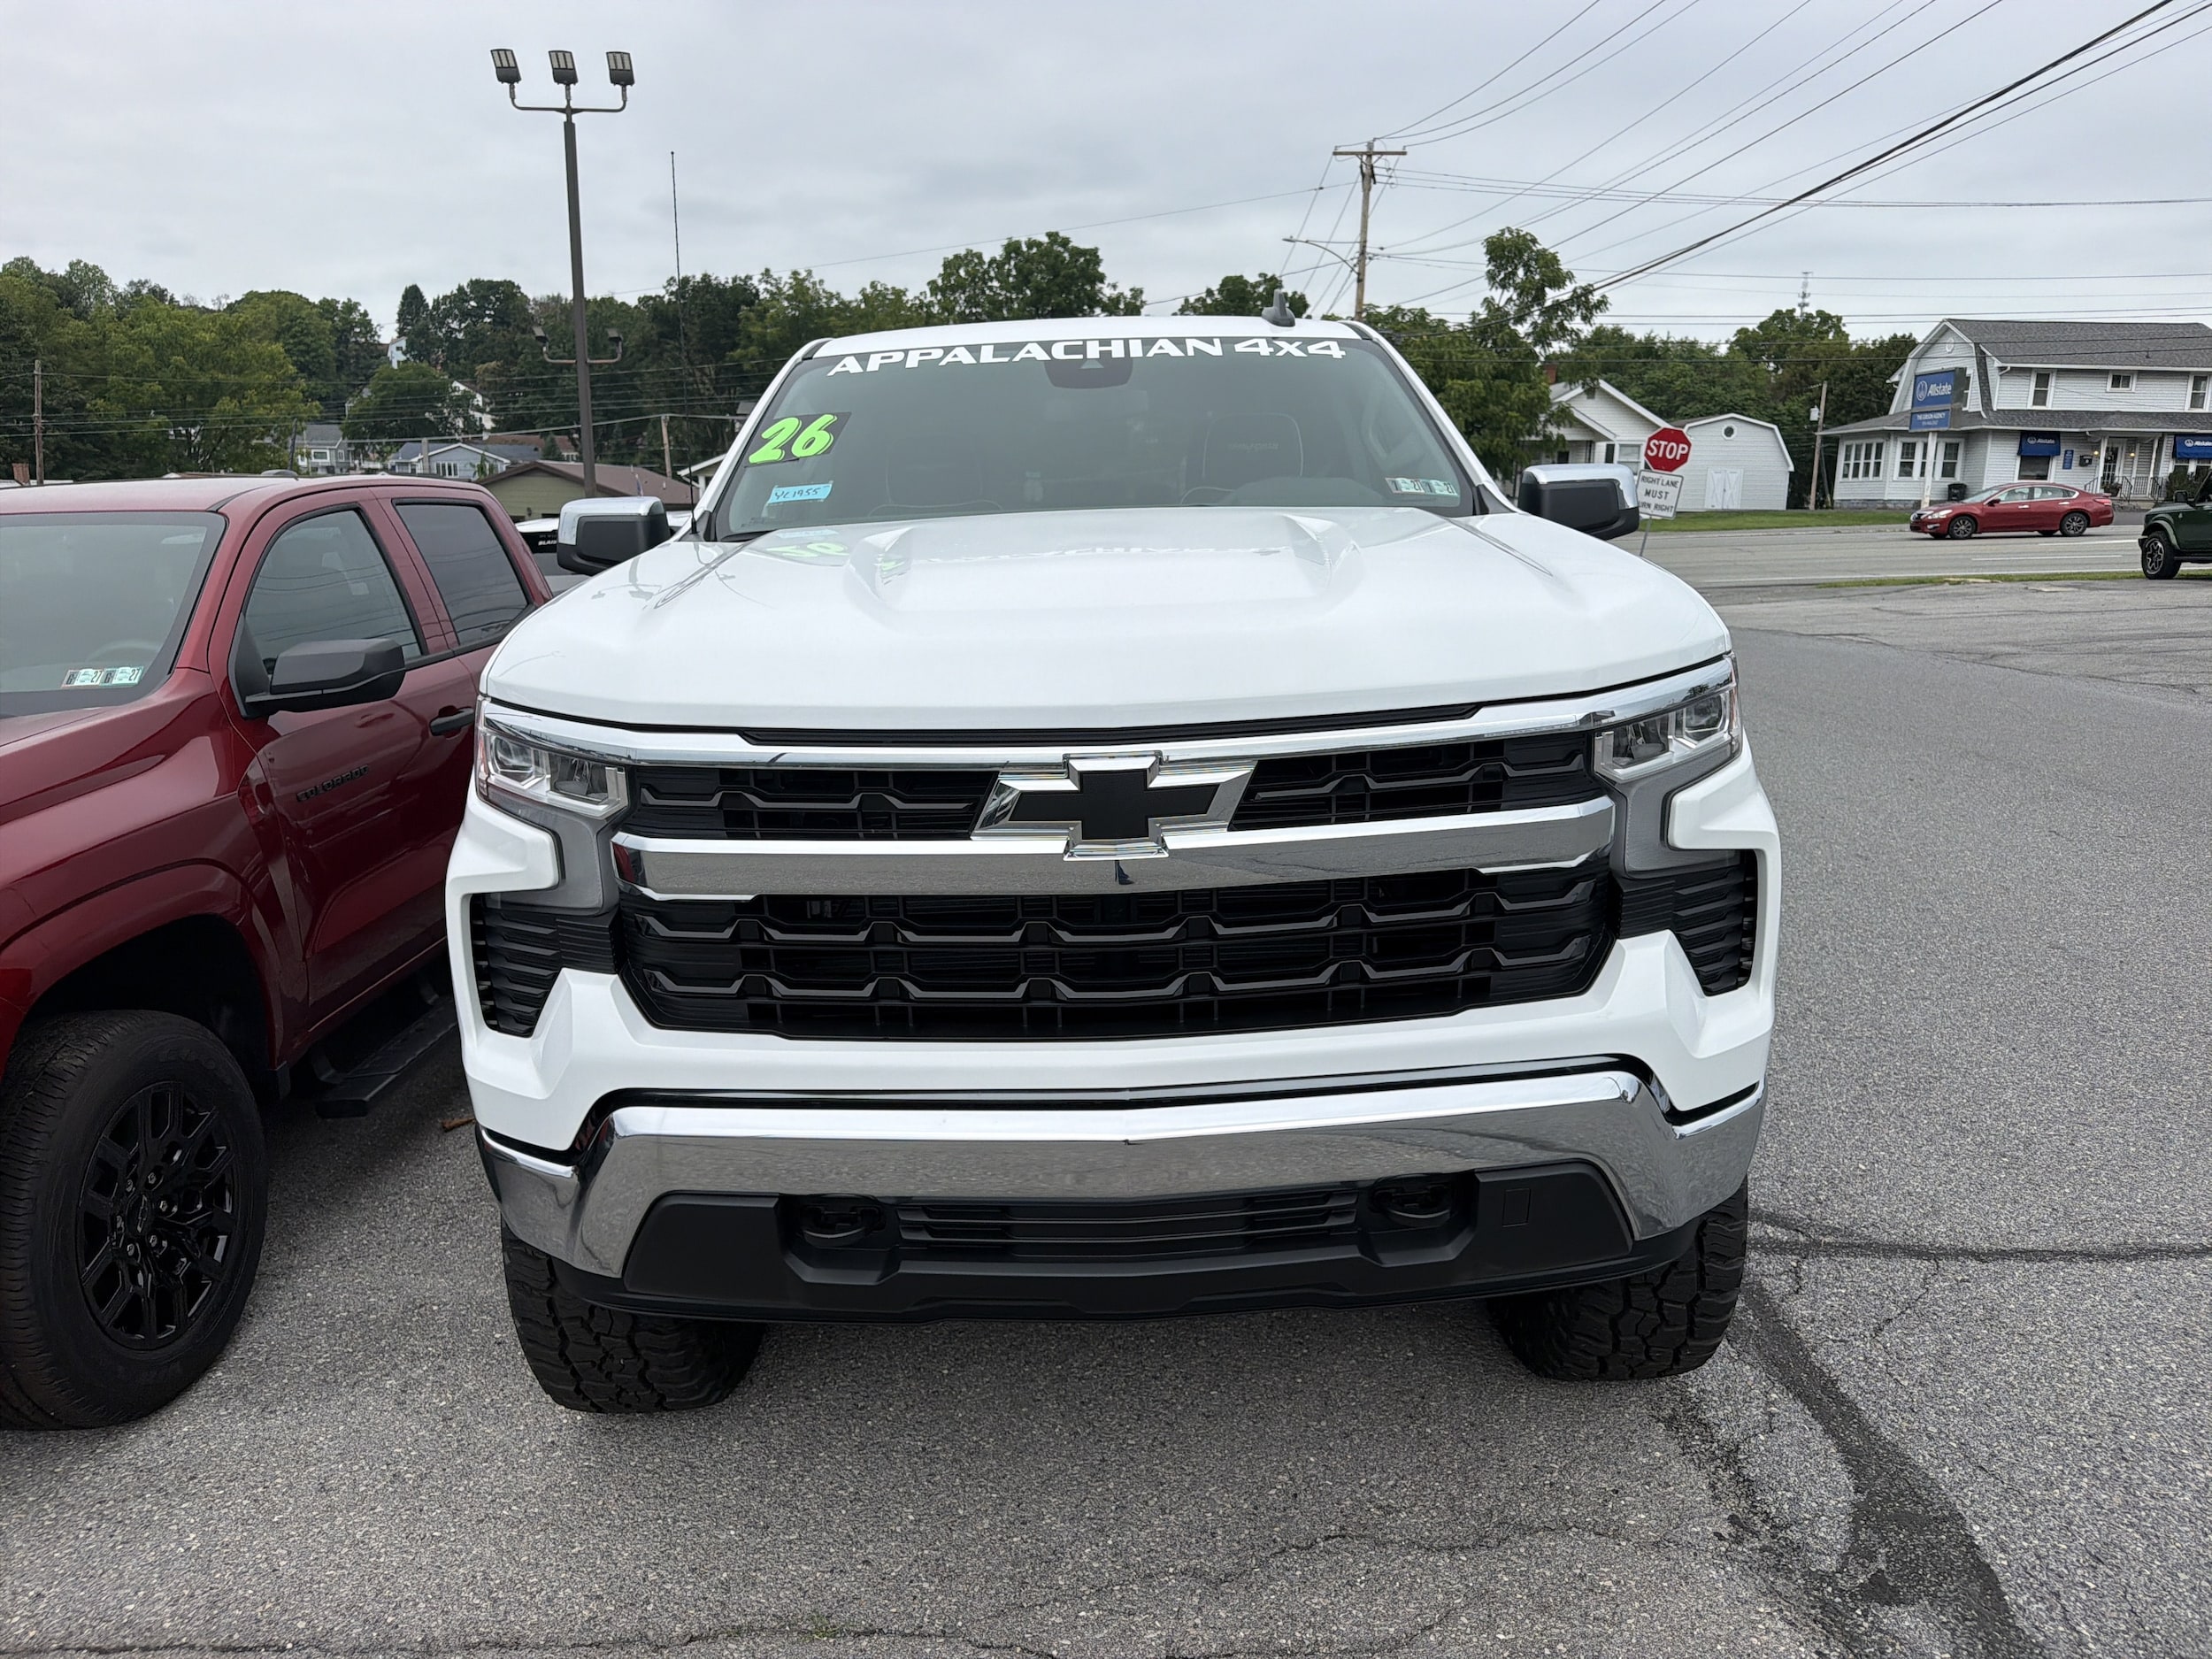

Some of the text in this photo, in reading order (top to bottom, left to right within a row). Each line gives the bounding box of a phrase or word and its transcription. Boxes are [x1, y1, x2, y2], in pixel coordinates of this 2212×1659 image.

[826, 338, 1347, 376] APPALACHIAN 4x4
[1927, 382, 1952, 396] Allstate
[749, 413, 837, 464] 26
[1647, 439, 1689, 460] STOP
[1641, 475, 1679, 488] RIGHT LANE
[1644, 488, 1670, 500] MUST
[1638, 501, 1674, 512] URN RIGHT
[296, 764, 369, 803] COLORADO
